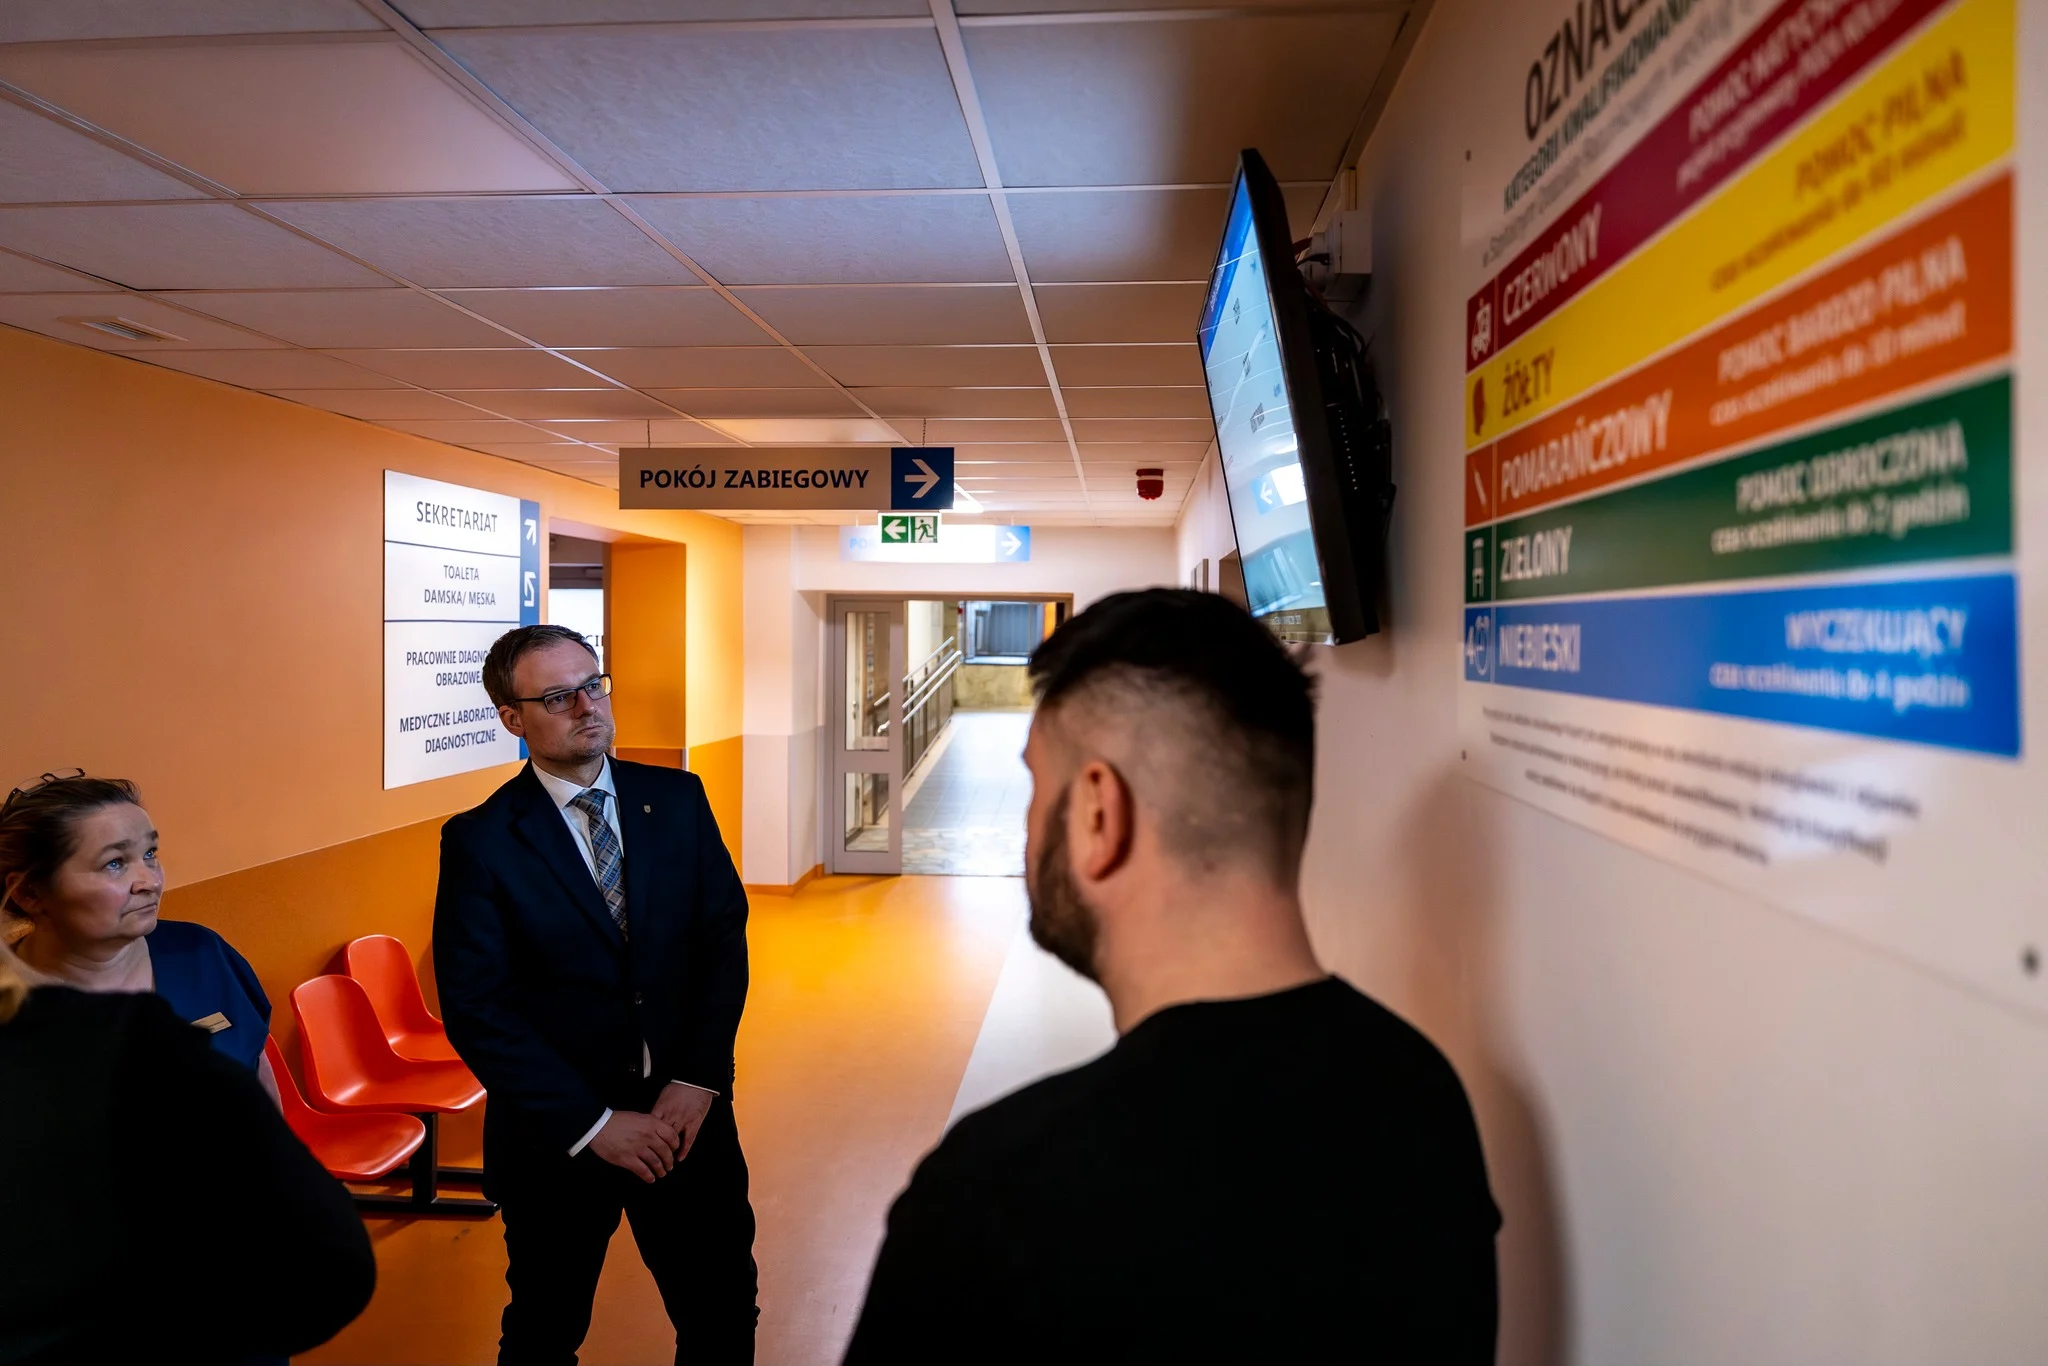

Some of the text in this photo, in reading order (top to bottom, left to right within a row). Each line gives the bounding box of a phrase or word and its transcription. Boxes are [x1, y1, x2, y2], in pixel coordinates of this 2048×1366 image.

[1503, 202, 1602, 326] CZERWONY
[1503, 347, 1555, 418] ŻÓŁTY
[1502, 387, 1673, 503] POMARAŃCZOWY
[640, 464, 869, 488] POKÓJ ZABIEGOWY
[417, 501, 498, 533] SEKRETARIAT
[1501, 525, 1573, 582] ZIELONY
[444, 565, 480, 581] TOALETA
[407, 651, 457, 666] PRACOWNIE
[1500, 623, 1581, 673] NIEBIESKI
[400, 712, 450, 733] MEDYCZNE
[425, 729, 496, 754] DIAGNOSTYCZNE
